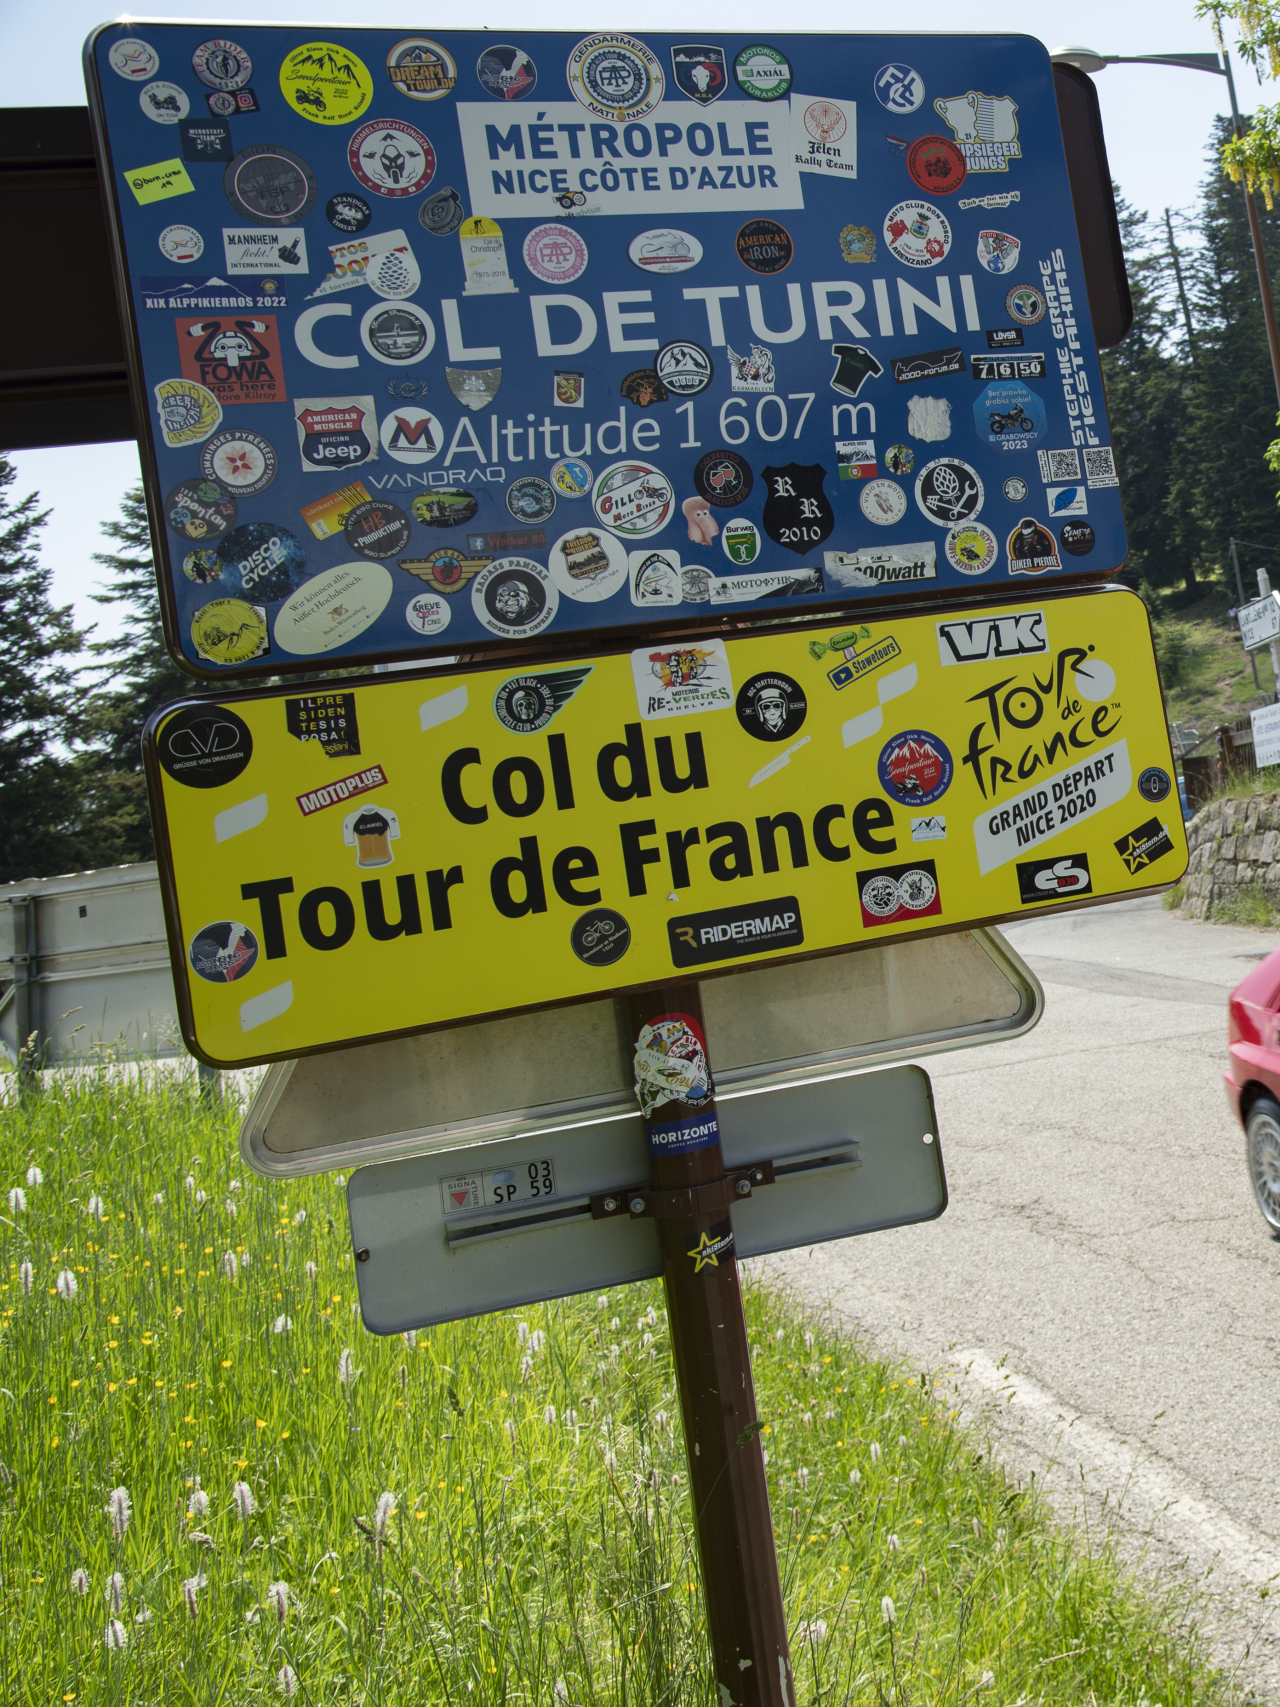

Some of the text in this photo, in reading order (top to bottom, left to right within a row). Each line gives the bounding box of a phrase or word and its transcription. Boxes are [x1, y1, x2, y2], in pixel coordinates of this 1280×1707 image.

[195, 44, 211, 74] TEAM
[213, 40, 251, 72] RIDERS
[573, 36, 656, 66] GENDARMERIE
[739, 48, 781, 63] MOTOROS
[285, 68, 352, 86] Seealpentour
[391, 65, 442, 81] DREAM
[755, 68, 786, 78] AXIÁL
[407, 78, 455, 92] TOUR.DK
[744, 81, 788, 98] TÚRAKLUB
[350, 121, 430, 152] HIMMELSRICHTUNGEN
[484, 111, 773, 160] MÉTROPOLE
[241, 146, 276, 159] GIGN
[921, 147, 945, 160] MFG
[794, 154, 854, 172] Rally Team
[491, 161, 779, 195] NICE CÔTE D'AZUR
[332, 196, 371, 215] STANDGAS
[887, 202, 950, 245] MOTO CLUB DON BOSCO
[226, 234, 279, 245] MANNHEIM
[738, 233, 789, 249] AMERICAN
[236, 246, 273, 262] fickt!
[750, 245, 779, 260] IRON
[890, 246, 933, 267] ARENZANO
[475, 270, 506, 278] 1975-2018
[145, 296, 287, 309] XIX ALPPIKIERROS 2022
[1038, 259, 1066, 339] GRAPE
[294, 274, 981, 369] COL DE TURINI
[199, 361, 275, 384] FOWA
[978, 361, 1041, 379] 7 6 50
[240, 381, 277, 392] here
[1056, 346, 1085, 446] STEPHIE
[306, 412, 358, 423] AMERICAN
[313, 421, 354, 431] MUSCLE
[442, 391, 876, 467] Altitude 1 607 m
[995, 431, 1039, 441] GRABOWSCY
[312, 443, 362, 460] Jeep
[1001, 440, 1028, 450] 2023
[203, 432, 233, 480] COMMINGES
[700, 451, 740, 469] GRUPPETTO
[255, 468, 273, 491] SOUFFLE
[367, 467, 506, 490] VANDRAQ
[773, 476, 798, 498] R
[862, 485, 876, 504] VIAJO
[886, 483, 903, 500] MOTO
[173, 493, 228, 531] spontan
[515, 511, 550, 523] BROTHERHOOD
[798, 497, 823, 519] R
[361, 510, 387, 533] HB
[725, 524, 755, 534] Burweg
[487, 533, 546, 548] Walker 88
[566, 535, 593, 550] FREEDOM
[779, 525, 822, 543] 2010
[238, 536, 282, 576] DISCO
[570, 542, 594, 556] RIDERS
[240, 554, 286, 590] CYCLE
[1011, 556, 1060, 570] BIKER PIERRE
[474, 560, 549, 595] BADASS PANDAS
[731, 575, 791, 590] МОТОФУНК
[288, 571, 352, 613] Wir können alles.
[292, 576, 364, 626] Außer Hochdeutsch.
[412, 601, 441, 612] GRÈVE
[485, 607, 554, 636] RIDERS FOR ORPHANS
[938, 612, 1047, 663] VK
[851, 640, 897, 675] Stawetours
[506, 677, 538, 691] FAT BLACK
[671, 687, 701, 697] MOTEROS
[747, 678, 794, 698] MC MATTERHORN
[647, 686, 731, 716] RE-VERDES
[1060, 695, 1083, 721] de
[172, 751, 244, 770] GRÜSSE VON DRAUSSEN
[884, 756, 936, 780] Seealpentour
[440, 721, 710, 824] Col du
[299, 767, 383, 814] MOTOPLUS
[988, 752, 1116, 836] GRAND DÉPART
[1014, 787, 1098, 848] NICE 2020
[239, 864, 465, 961] Tour
[490, 834, 603, 919] de
[618, 797, 898, 898] France
[1057, 876, 1079, 887] 030
[699, 911, 797, 946] RIDERMAP
[771, 929, 798, 940] PLAYGROUND
[582, 927, 629, 960] Monsieur et Madame
[196, 952, 242, 971] ASTONISHING
[204, 959, 235, 975] DRIVERS
[651, 1120, 718, 1146] HORIZONTE
[527, 1160, 552, 1180] 03
[493, 1177, 554, 1204] SP 59
